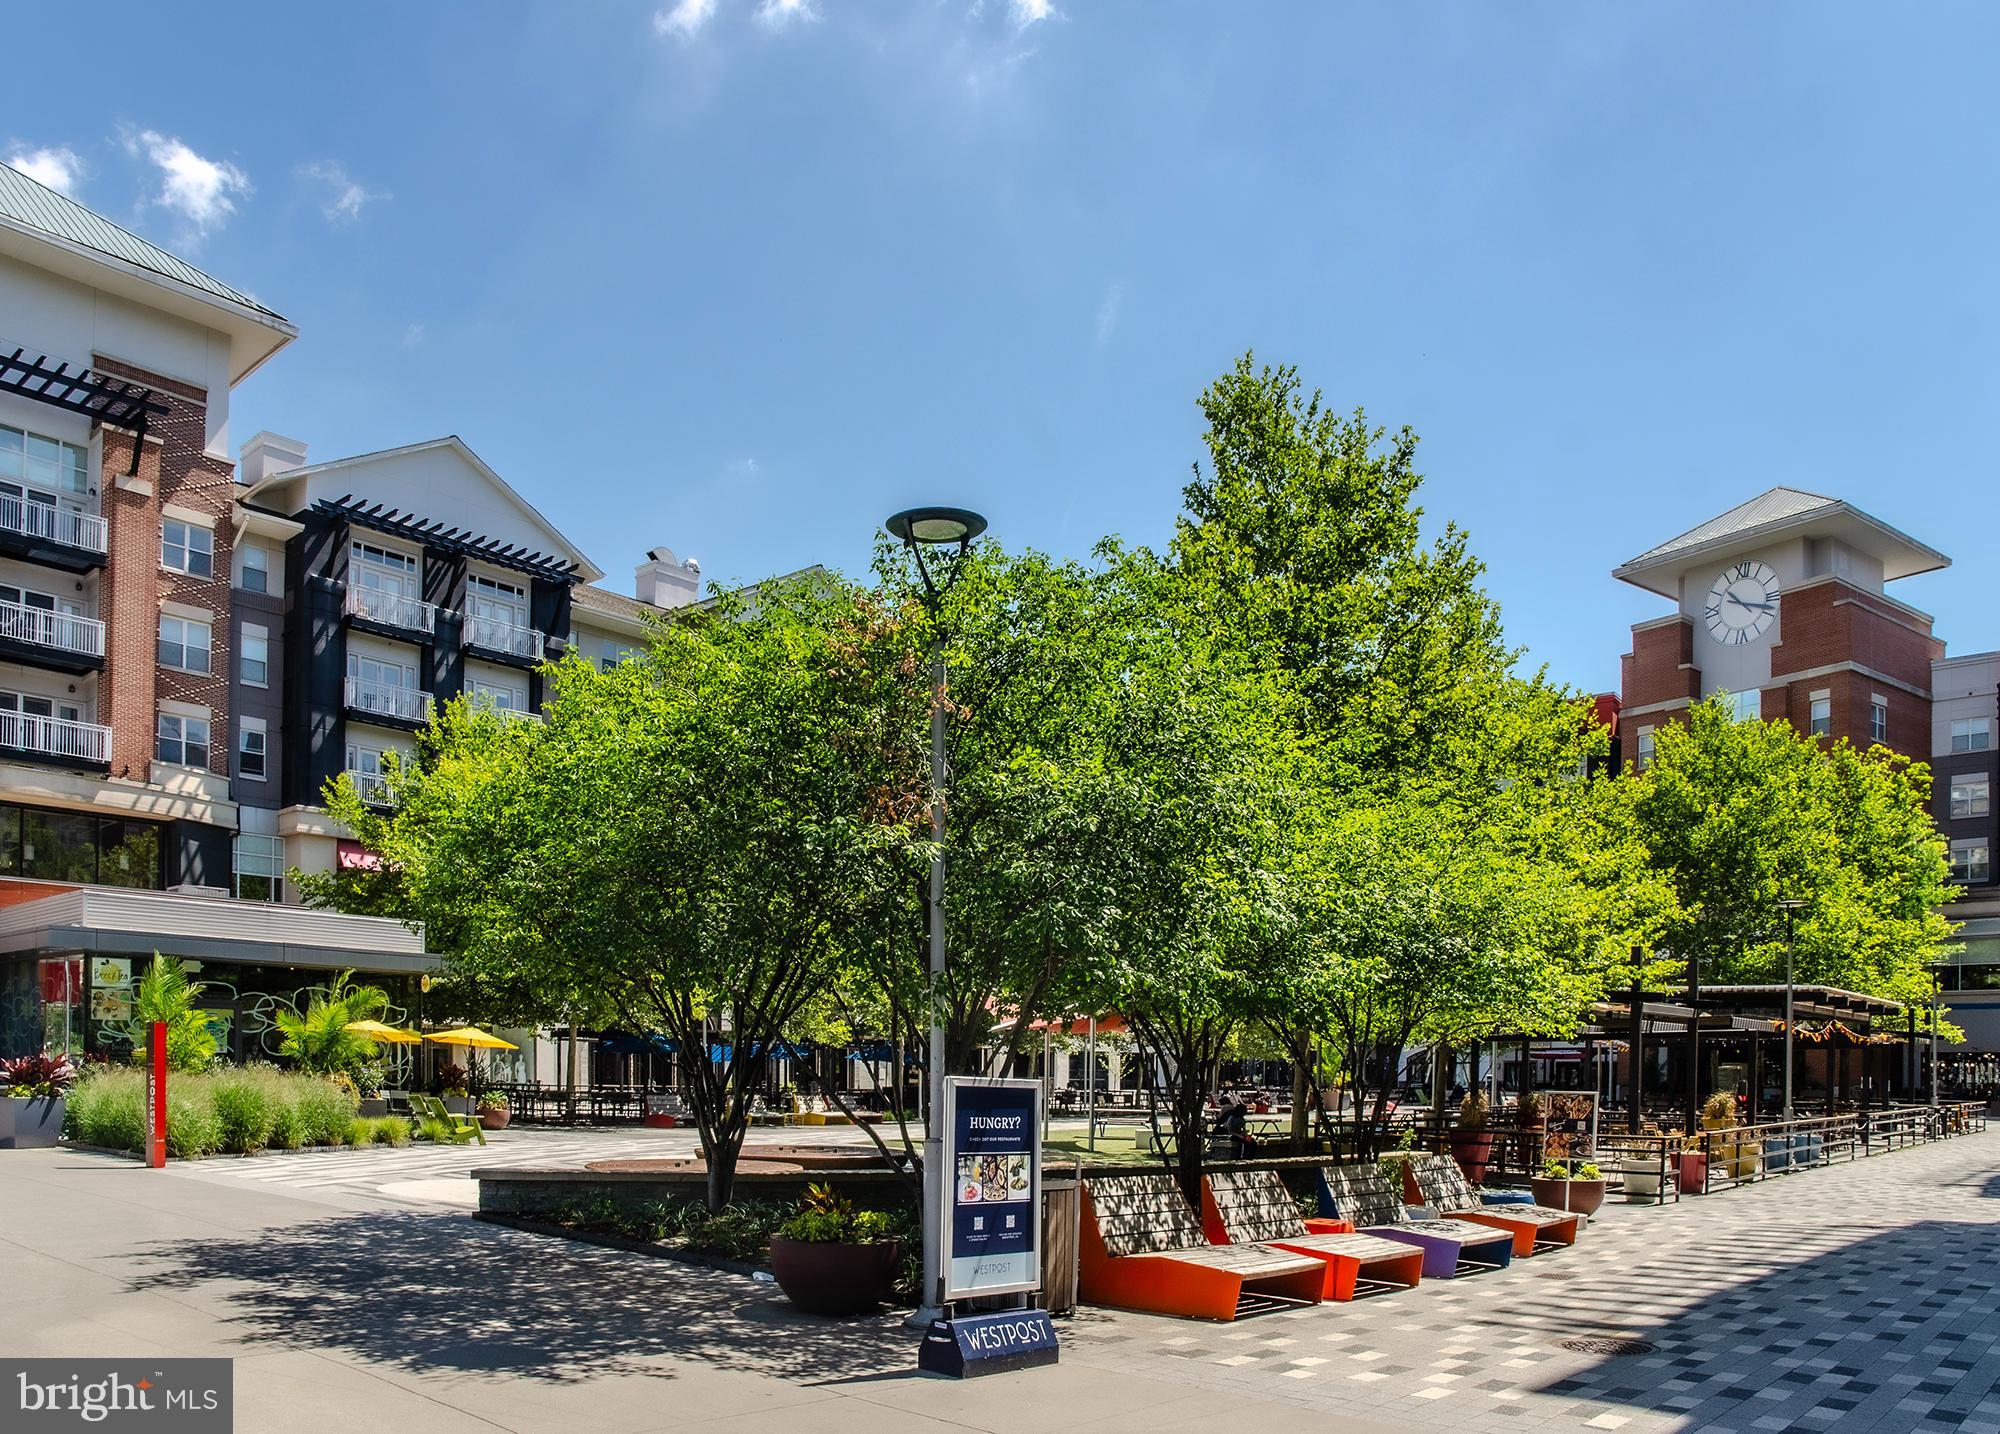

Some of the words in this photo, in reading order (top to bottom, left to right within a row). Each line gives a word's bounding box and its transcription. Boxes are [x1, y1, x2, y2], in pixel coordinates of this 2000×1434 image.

[970, 1116, 1021, 1129] HUNGRY?
[973, 1262, 1011, 1275] WESTPOST
[964, 1320, 1047, 1350] WESTPOST
